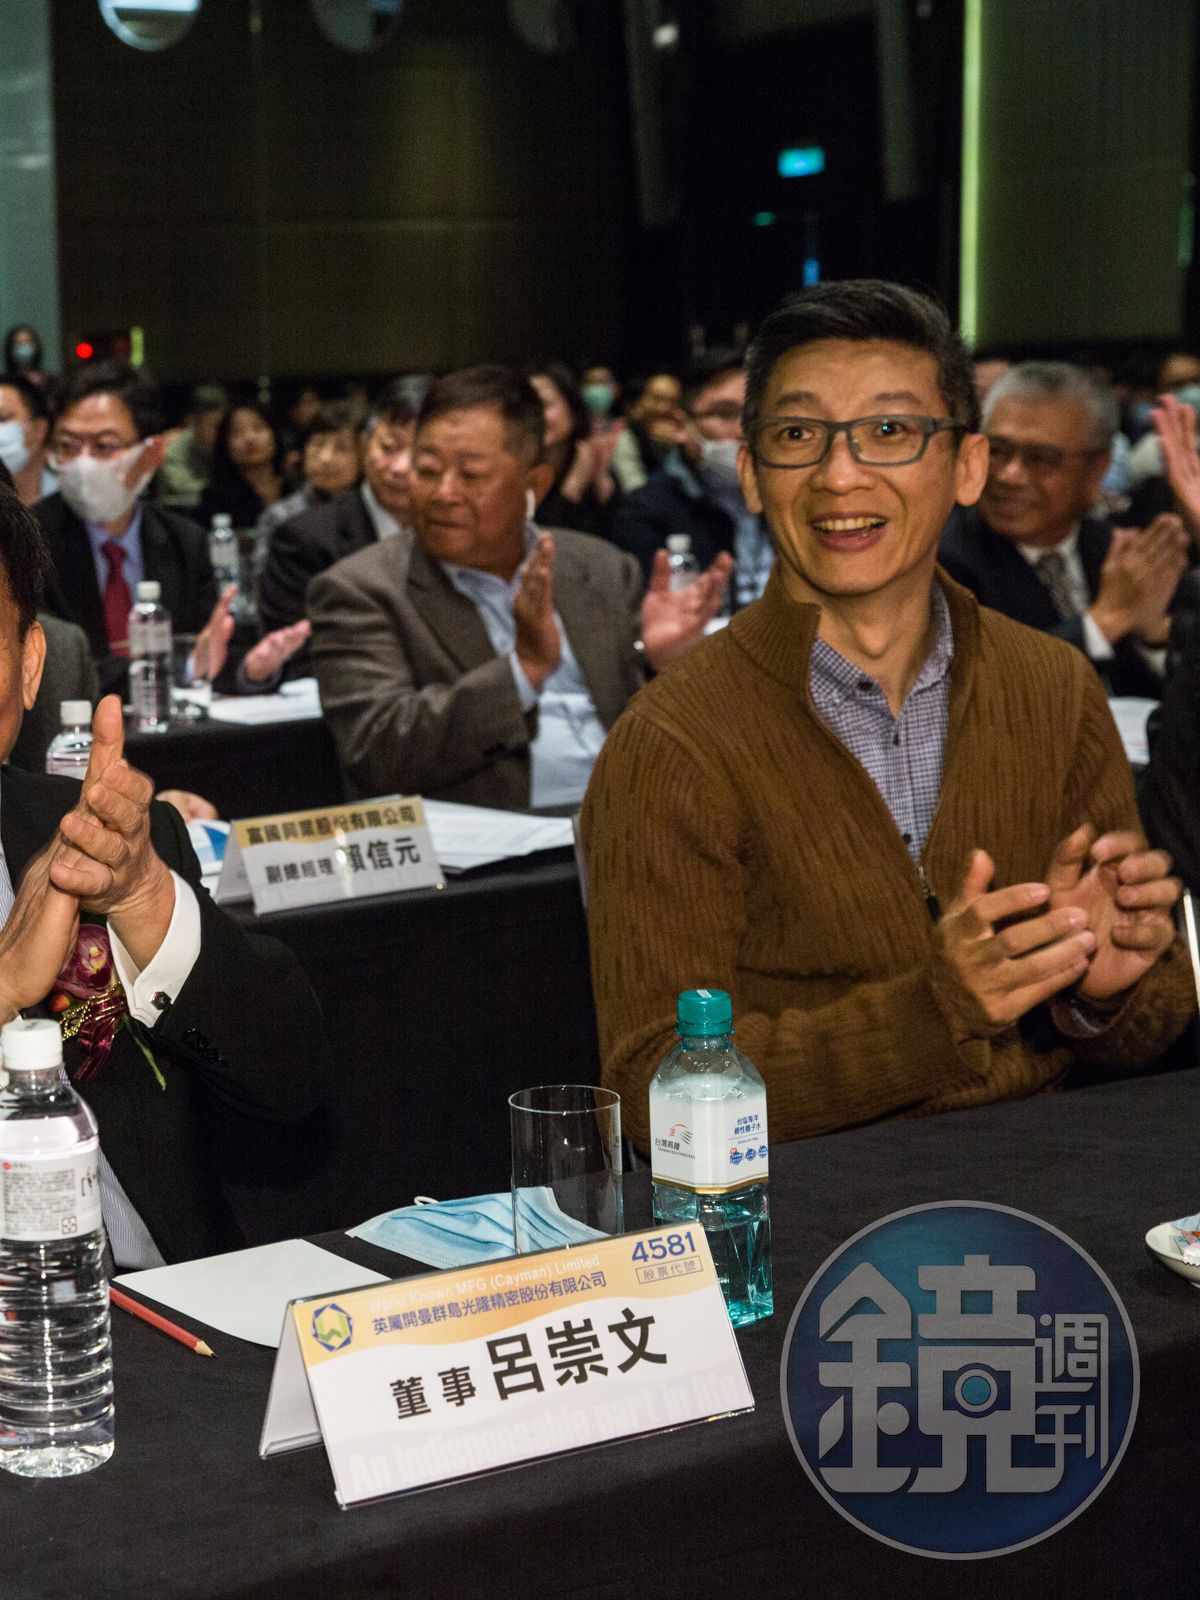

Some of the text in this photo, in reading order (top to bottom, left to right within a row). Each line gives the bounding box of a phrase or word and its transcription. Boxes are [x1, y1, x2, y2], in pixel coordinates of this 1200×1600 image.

[632, 1231, 697, 1262] 4581
[410, 1286, 454, 1306] Known
[456, 1277, 487, 1295] MFG
[490, 1268, 552, 1293] (Cayman)
[555, 1255, 601, 1275] Limited
[643, 1260, 697, 1281] 股票代號
[486, 1307, 668, 1400] 呂崇文
